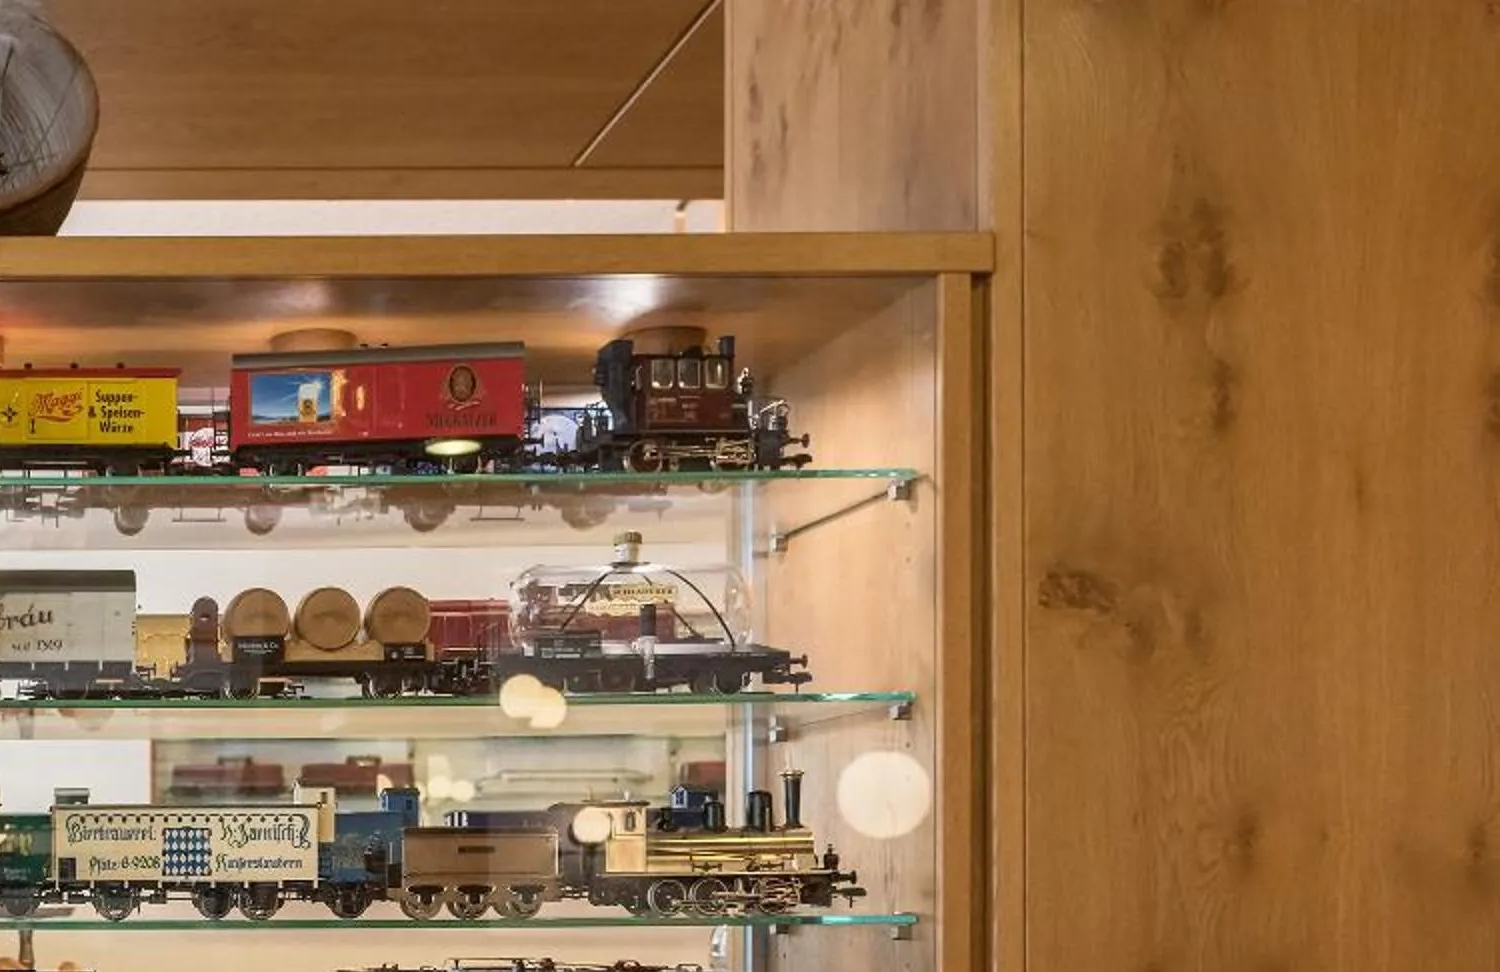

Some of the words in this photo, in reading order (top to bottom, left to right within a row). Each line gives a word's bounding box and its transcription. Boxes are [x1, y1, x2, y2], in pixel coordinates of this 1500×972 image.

[96, 389, 138, 405] Suppen-
[88, 406, 97, 418] &
[101, 405, 145, 420] Speisen-
[100, 420, 134, 433] Würze
